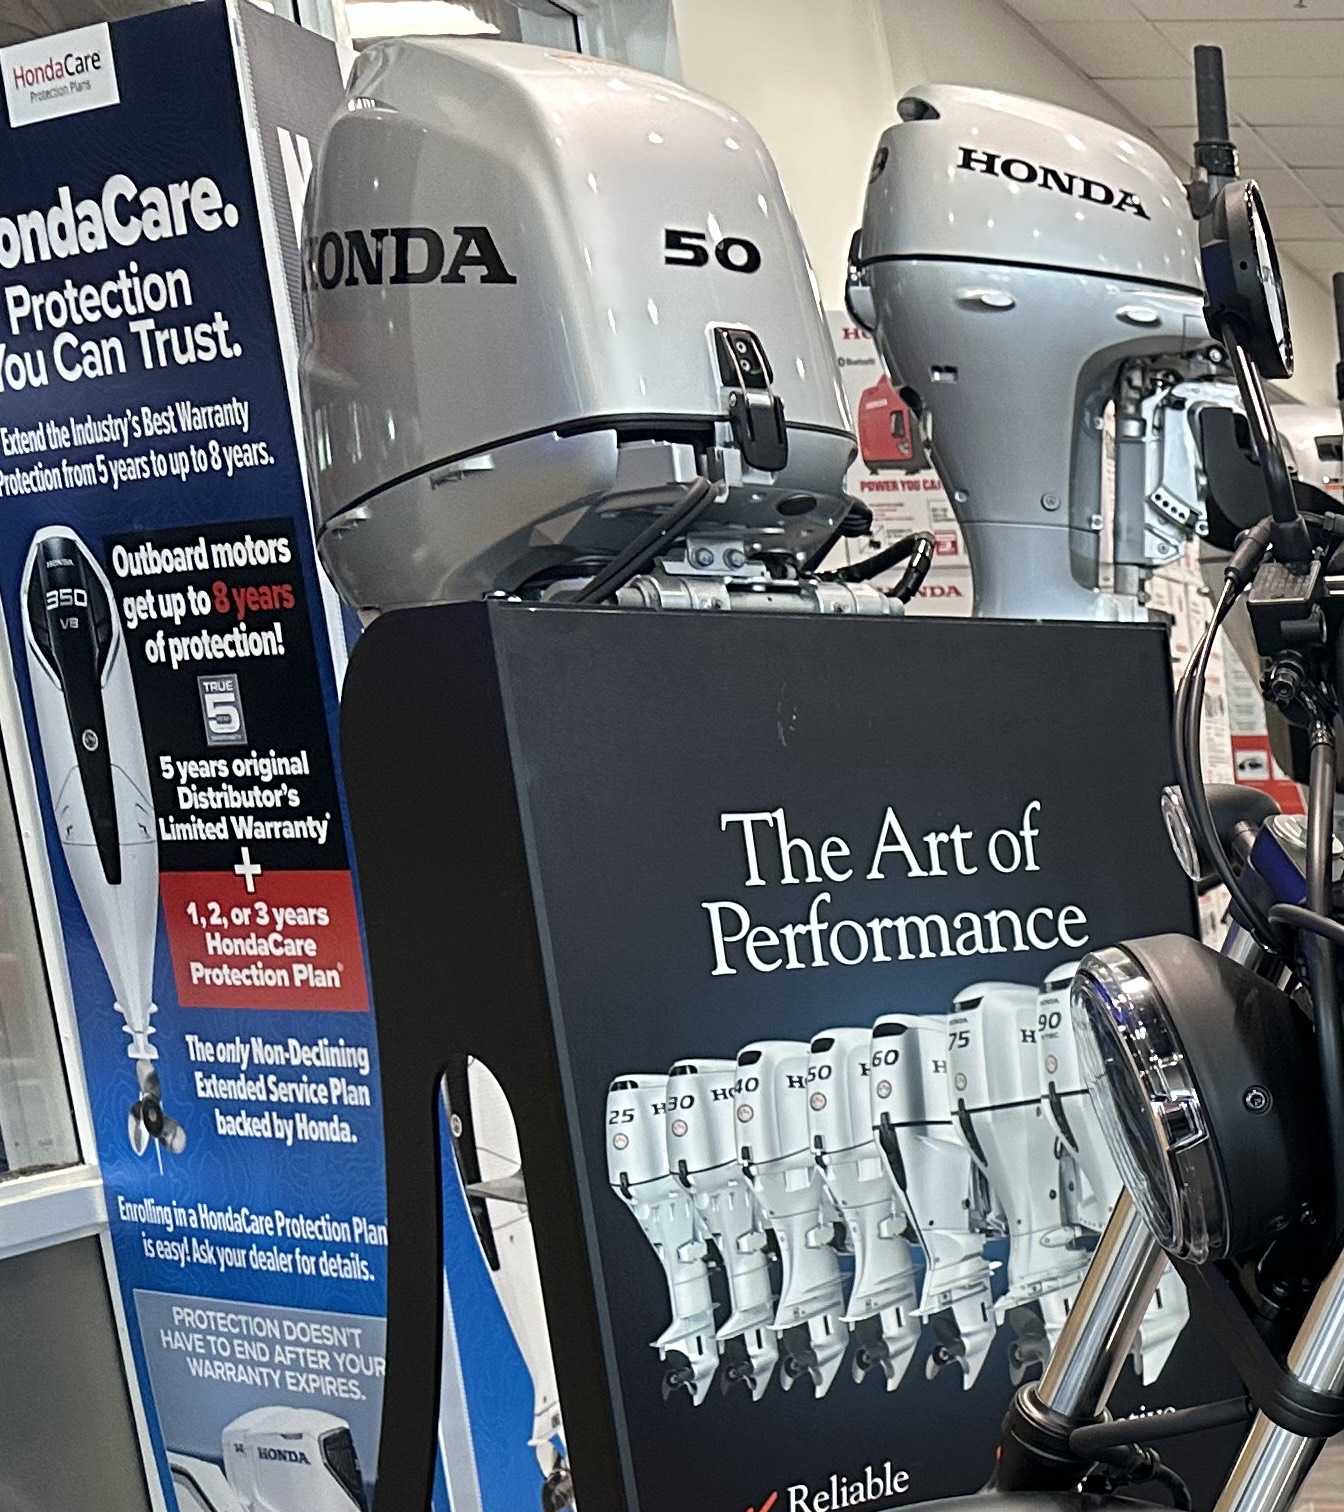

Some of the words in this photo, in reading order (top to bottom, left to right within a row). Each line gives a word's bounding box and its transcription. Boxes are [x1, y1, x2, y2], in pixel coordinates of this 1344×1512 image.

[13, 50, 102, 90] HondaCare
[957, 146, 1150, 222] HONDA
[0, 174, 240, 269] ondaCare.
[303, 226, 517, 292] ONDA
[665, 228, 761, 274] 50
[5, 262, 193, 334] Protection
[53, 335, 126, 384] Can
[130, 311, 243, 370] Trust.
[2, 422, 48, 456] Extend
[47, 418, 71, 447] the
[72, 408, 142, 448] Industry's
[143, 404, 177, 434] Best
[178, 397, 250, 434] Warranty
[0, 460, 62, 498] Protection
[61, 456, 97, 488] from
[98, 456, 108, 484] 5
[109, 458, 150, 489] years
[151, 450, 167, 477] to
[169, 453, 187, 483] up
[188, 446, 207, 472] to
[209, 442, 221, 469] 8
[222, 443, 275, 476] years.
[860, 480, 898, 492] POWER
[900, 480, 921, 492] YOU
[112, 541, 207, 579] Outboard
[212, 535, 291, 569] motors
[45, 589, 88, 610] 350
[123, 592, 158, 629] get
[159, 594, 189, 625] up
[190, 588, 211, 617] to
[213, 581, 228, 614] 8
[229, 581, 296, 619] years
[60, 616, 79, 630] V8
[145, 632, 168, 663] of
[171, 622, 286, 669] protection!
[203, 681, 234, 693] TRUE
[205, 693, 240, 734] 5
[160, 756, 174, 779] 5
[176, 758, 229, 787] years
[231, 751, 310, 786] original
[178, 784, 300, 811] Distributor's
[158, 816, 228, 841] Limited
[720, 808, 853, 886] The
[867, 807, 977, 880] Art
[988, 801, 1042, 875] of
[187, 904, 206, 928] 1,
[207, 906, 228, 928] 2,
[230, 910, 253, 925] or
[255, 905, 269, 925] 3
[271, 907, 330, 931] years
[702, 892, 1091, 977] Performance
[205, 932, 317, 957] HondaCare
[190, 961, 290, 987] Protection
[949, 1030, 970, 1050] 75
[1038, 1011, 1062, 1032] 90
[184, 1034, 214, 1062] The
[216, 1036, 249, 1071] only
[250, 1037, 370, 1075] Non-Declining
[807, 1065, 832, 1083] 50
[872, 1050, 899, 1067] 60
[194, 1071, 266, 1103] Extended
[267, 1074, 329, 1105] Service
[329, 1077, 371, 1106] Plan
[668, 1095, 695, 1111] 30
[734, 1077, 760, 1093] 40
[215, 1108, 272, 1139] backed
[273, 1110, 294, 1147] by
[295, 1112, 358, 1144] Honda.
[609, 1108, 635, 1125] 25
[117, 1195, 173, 1232] Enrolling
[175, 1200, 188, 1222] in
[188, 1209, 198, 1225] a
[198, 1203, 274, 1237] HondaCare
[275, 1210, 351, 1242] Protection
[352, 1217, 388, 1246] Plan
[142, 1232, 155, 1258] is
[155, 1237, 190, 1269] easy!
[191, 1238, 216, 1265] Ask
[216, 1245, 248, 1272] your
[249, 1244, 294, 1274] dealer
[294, 1247, 317, 1276] for
[318, 1250, 375, 1281] details.
[172, 1306, 281, 1340] PROTECTION
[283, 1320, 362, 1349] DOESN'T
[160, 1328, 206, 1354] HAVE
[206, 1336, 232, 1356] TO
[233, 1338, 271, 1362] END
[273, 1346, 332, 1372] AFTER
[334, 1352, 386, 1377] YOUR
[186, 1356, 283, 1390] WARRANTY
[285, 1373, 367, 1402] EXPIRES.
[257, 1446, 311, 1465] HONDA
